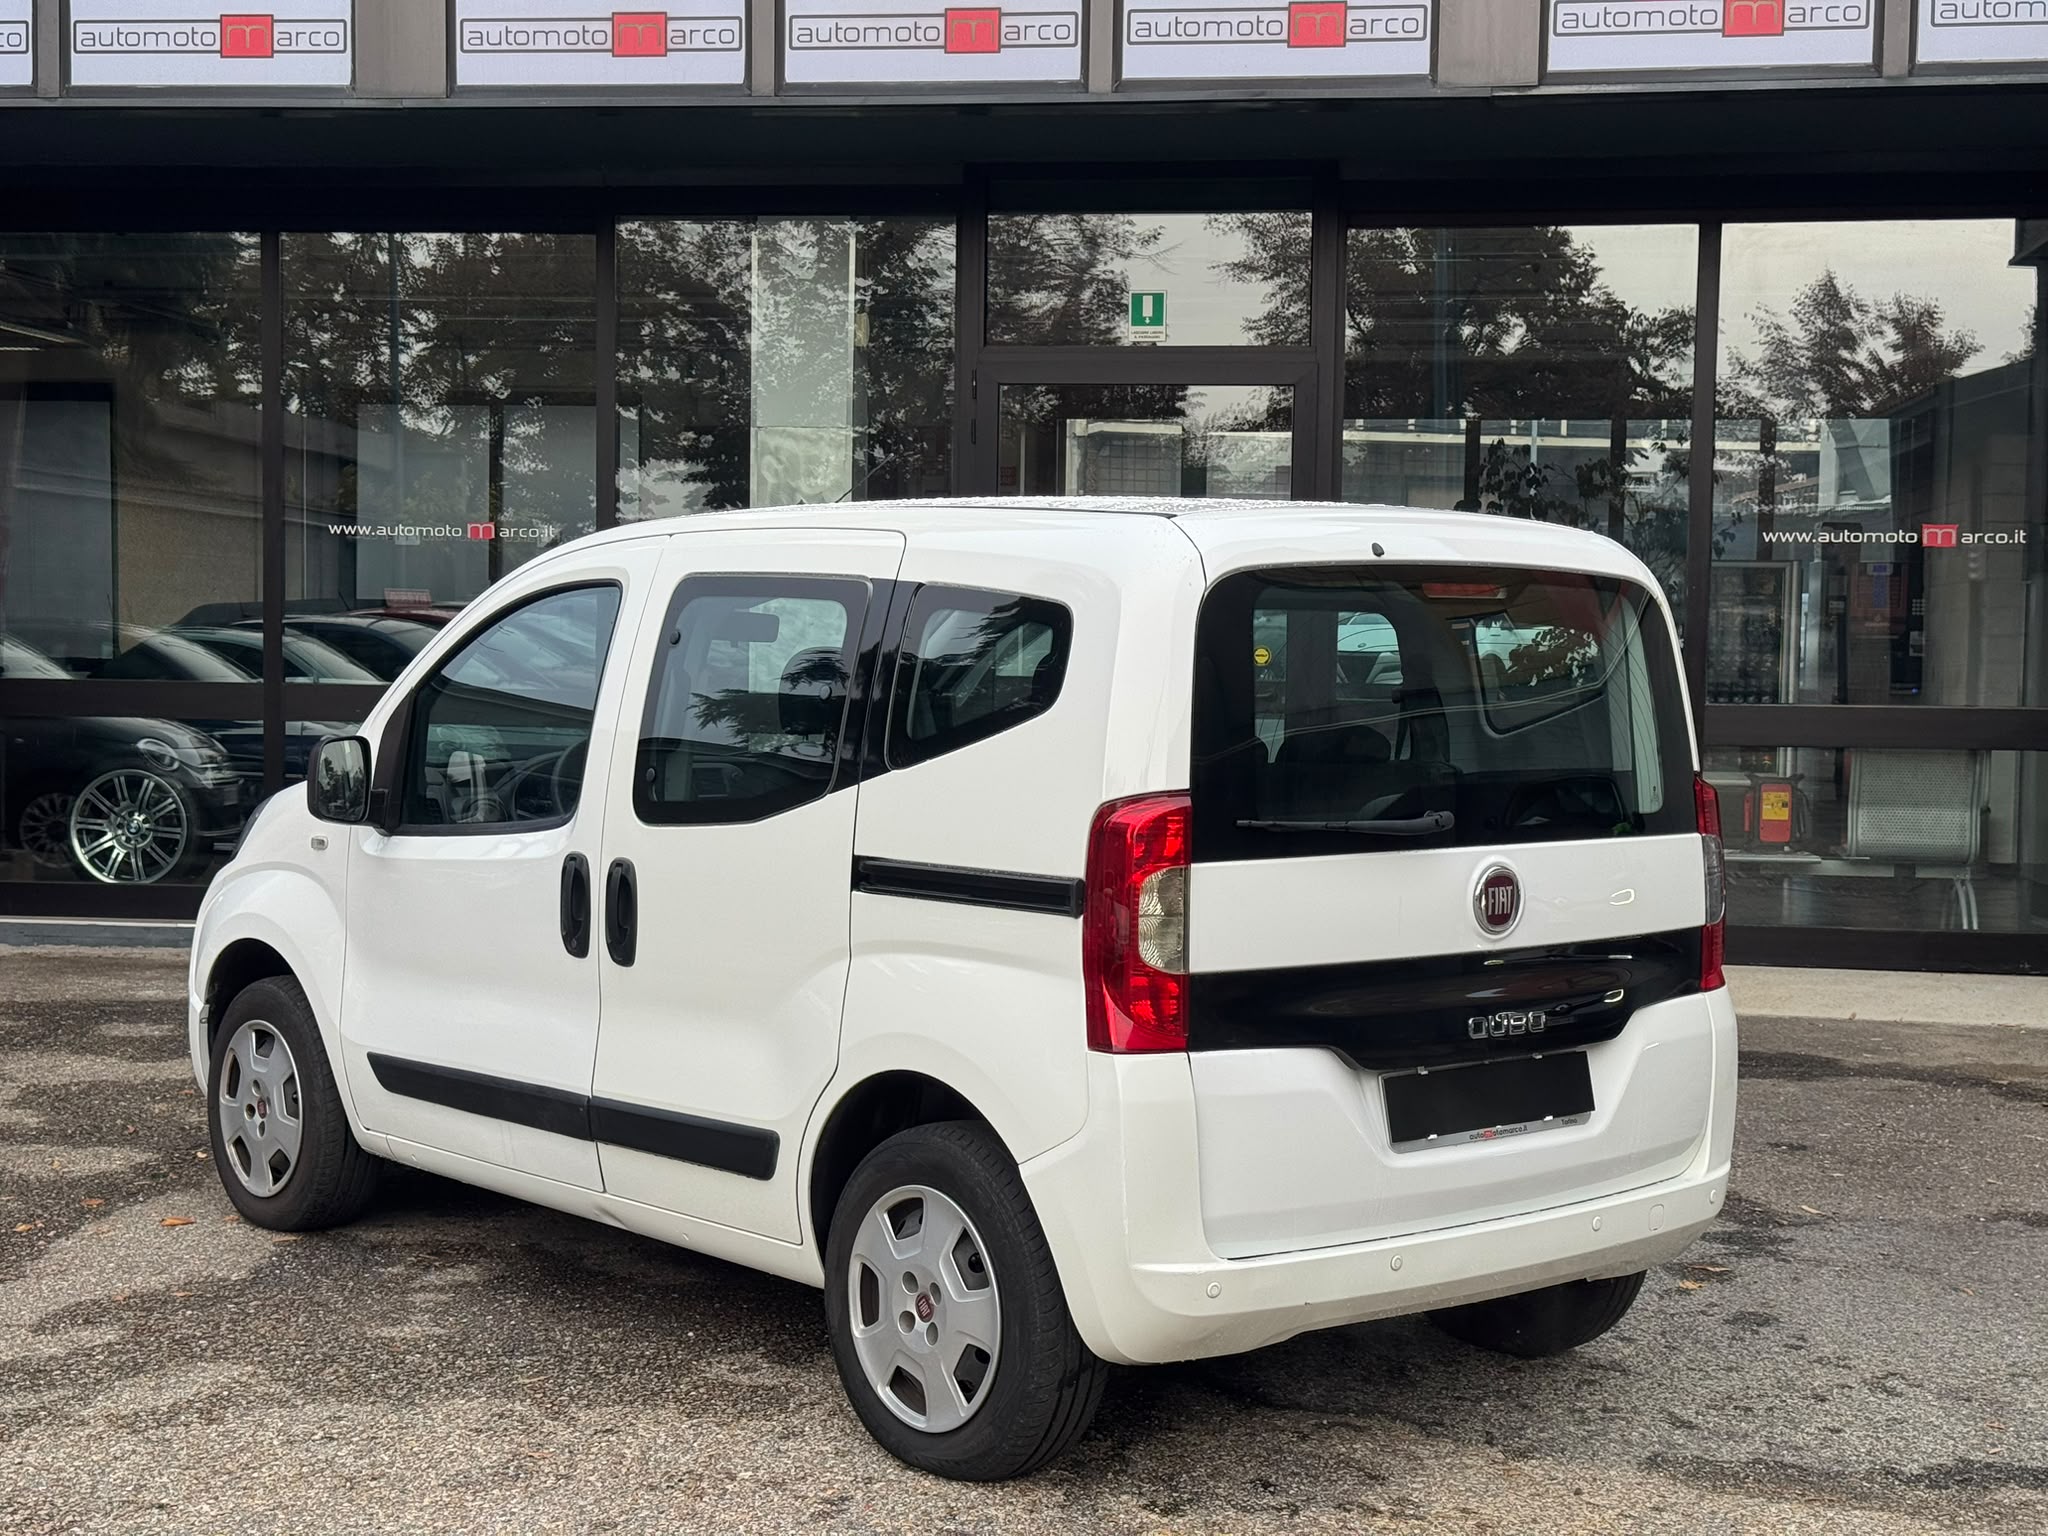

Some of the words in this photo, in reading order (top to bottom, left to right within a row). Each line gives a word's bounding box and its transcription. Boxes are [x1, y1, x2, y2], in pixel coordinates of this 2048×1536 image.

[1939, 0, 2048, 20] autom
[1487, 885, 1513, 916] FIAT
[1468, 1010, 1546, 1039] QUBO
[918, 1298, 930, 1317] FIAT
